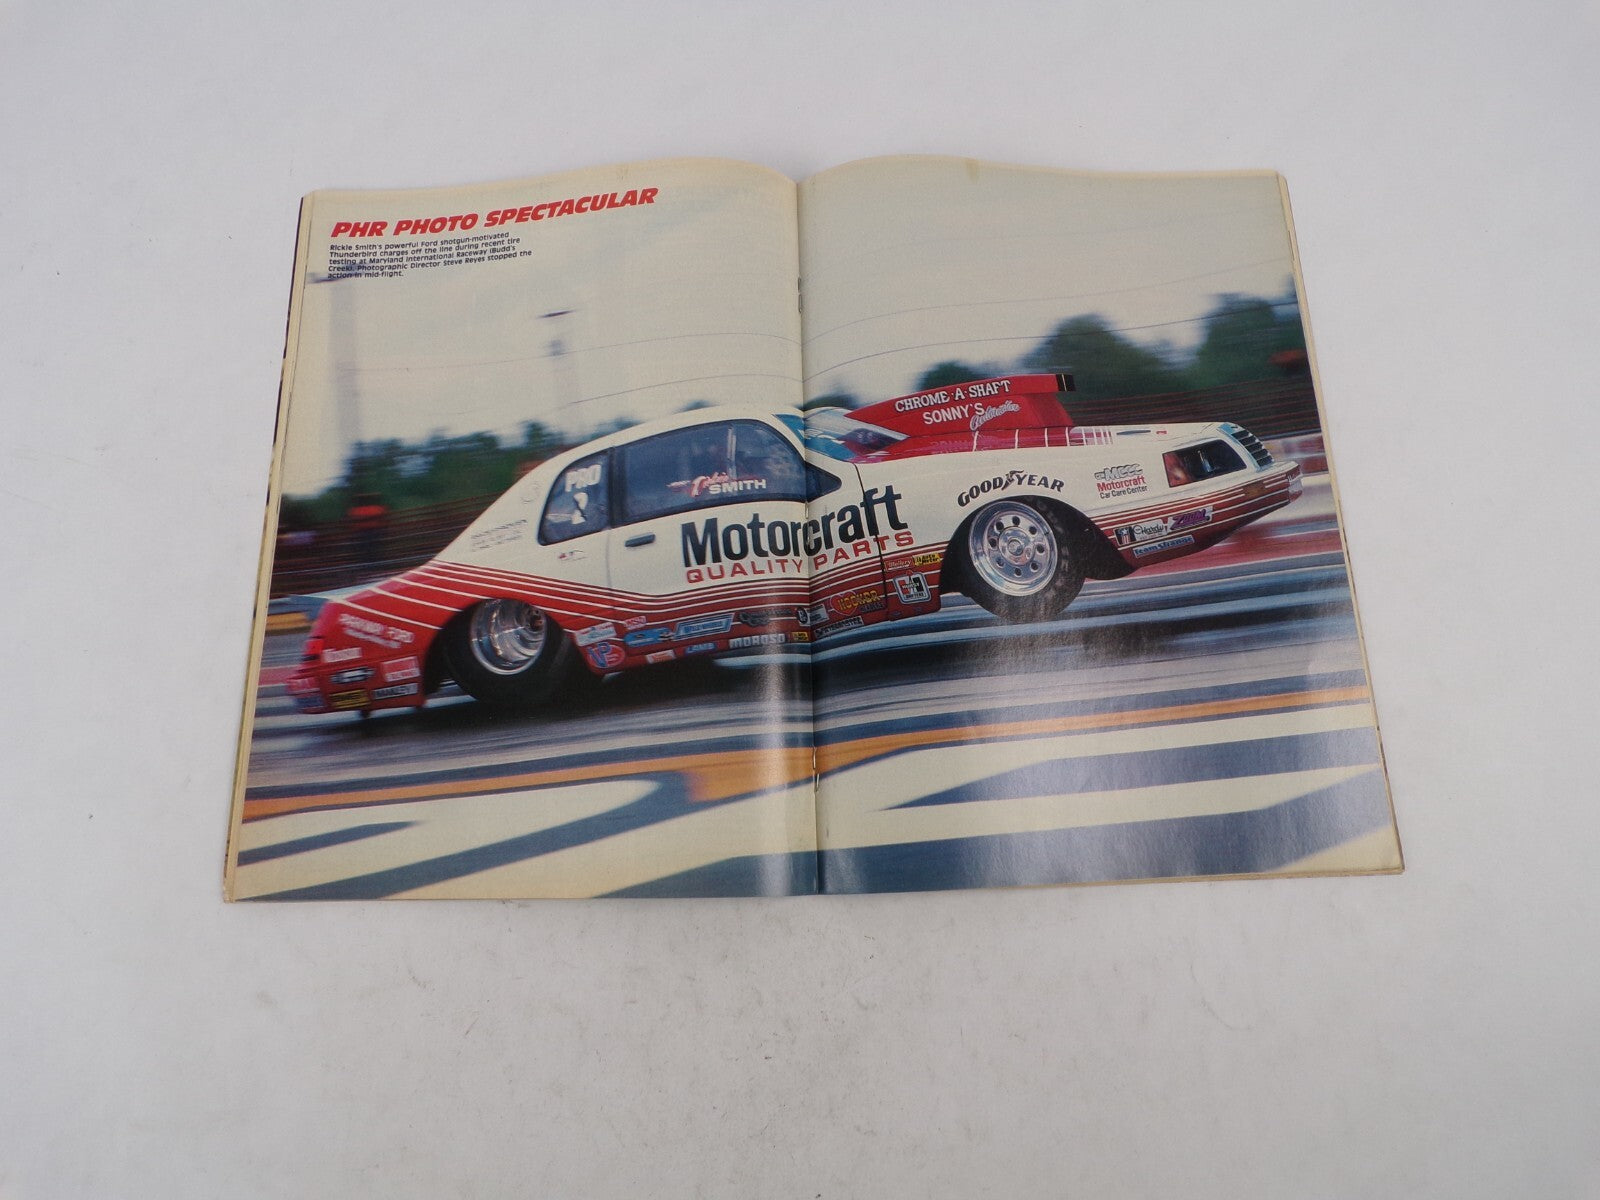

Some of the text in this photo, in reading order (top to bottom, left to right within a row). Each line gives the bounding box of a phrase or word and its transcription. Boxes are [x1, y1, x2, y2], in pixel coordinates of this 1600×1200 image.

[331, 187, 659, 238] PHR PHOTO SPECTACULAR
[330, 250, 378, 258] Thunderbird
[380, 249, 409, 259] charges
[440, 245, 453, 253] line
[455, 243, 479, 253] during
[481, 240, 505, 249] recent
[507, 237, 521, 245] tire
[355, 243, 383, 251] Smith's
[385, 241, 419, 251] powerful
[421, 240, 438, 248] Ford
[440, 231, 510, 246] shotgun-motivated
[329, 258, 357, 267] testing
[369, 255, 404, 265] Maryland
[406, 253, 454, 263] International
[457, 249, 487, 260] Raceway
[357, 263, 408, 273] Photographic
[410, 260, 441, 270] Director
[443, 258, 463, 267] Steve
[465, 256, 485, 266] Reyes
[487, 252, 518, 262] stopped
[364, 270, 404, 280] mid-flight.
[895, 392, 949, 412] CHROME
[969, 380, 1011, 398] SHAFT
[923, 403, 985, 425] SONNY'S
[565, 464, 602, 492] PRO
[709, 479, 767, 495] SMITH
[1097, 476, 1146, 492] Motorcraft
[1100, 485, 1148, 500] Car Care Center
[681, 485, 909, 569] Motorcraft
[686, 531, 915, 584] QUALITY PARTS
[730, 633, 785, 649] MOROSO
